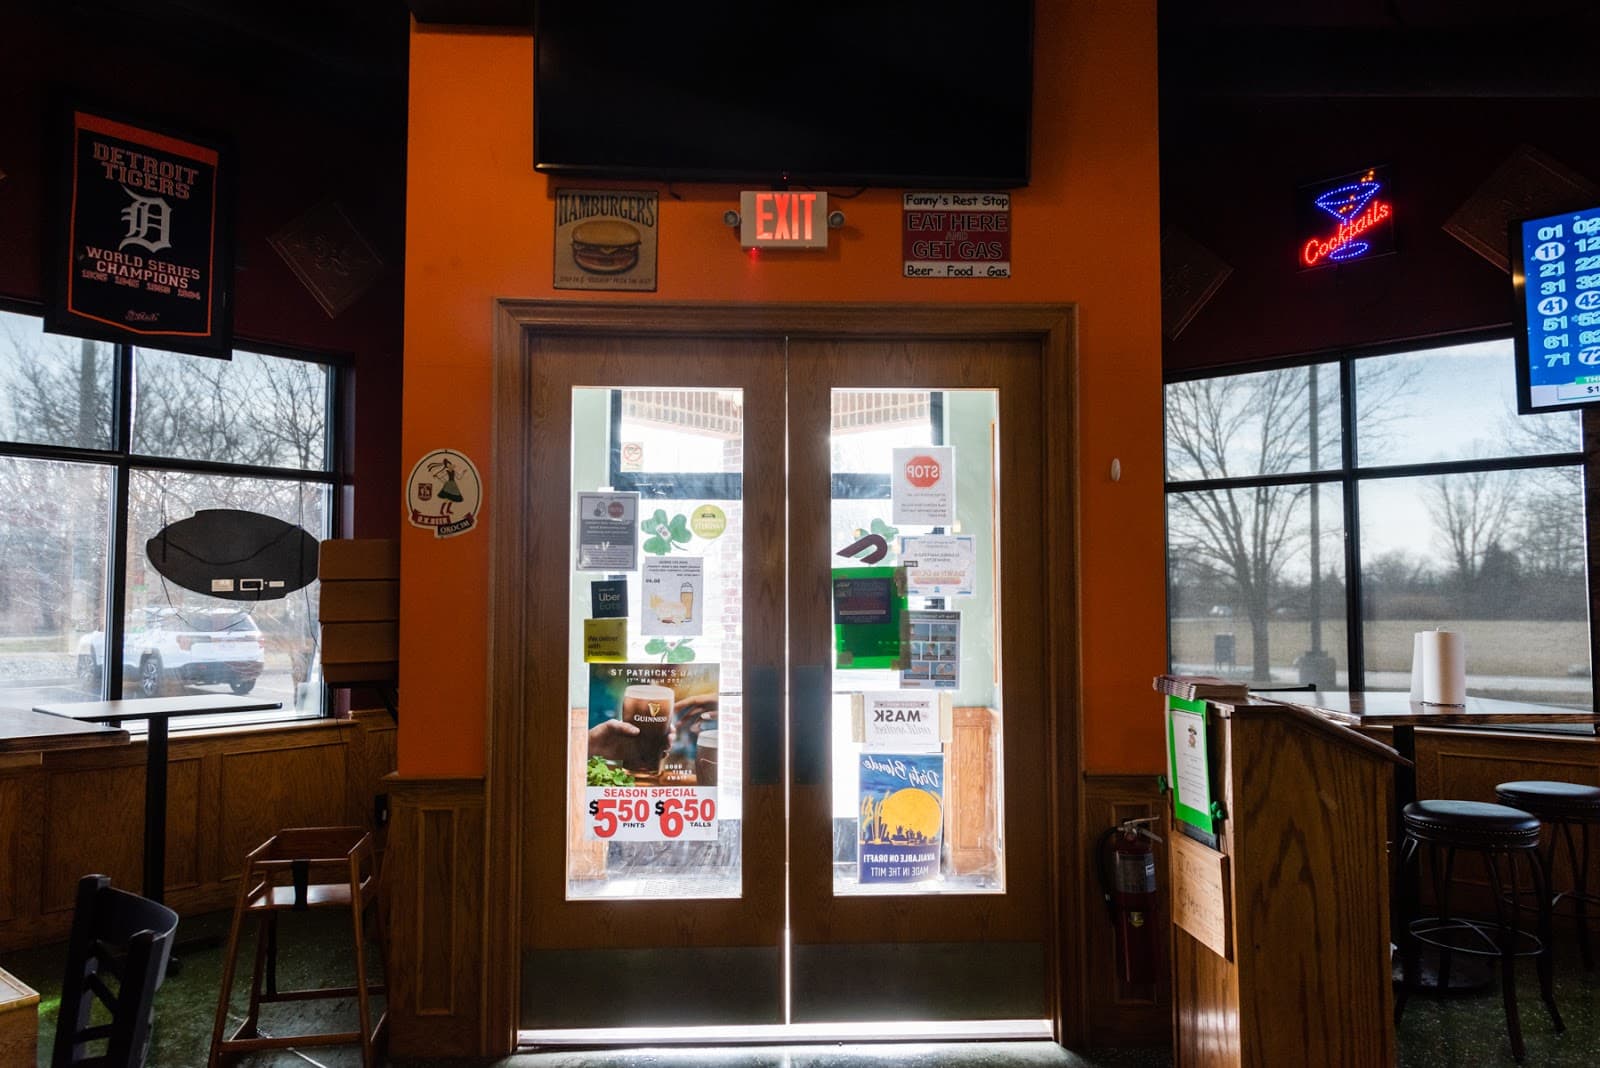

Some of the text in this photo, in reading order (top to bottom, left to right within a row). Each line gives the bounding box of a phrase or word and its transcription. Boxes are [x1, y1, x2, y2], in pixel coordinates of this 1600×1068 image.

[93, 142, 198, 185] DETROIT
[101, 162, 190, 200] TIGERS
[558, 192, 655, 228] HAMBURGERS
[905, 194, 1009, 208] Fanny's Rest Stop
[119, 184, 173, 253] D
[755, 193, 817, 241] EXIT
[908, 213, 1008, 232] EAT HERE
[1304, 201, 1389, 264] Cocktails
[1537, 217, 1600, 241] 01 02
[912, 240, 1003, 260] GET GAS
[1541, 238, 1600, 258] 11 12
[85, 246, 200, 280] WORLD SERIES
[907, 265, 1008, 277] Beer Food Gas
[1539, 256, 1600, 278] 21 22
[96, 260, 189, 289] CHAMPIONS
[1540, 275, 1600, 295] 31 32
[1543, 294, 1600, 313] 41 42
[1543, 312, 1600, 332] 51 52
[1543, 330, 1600, 350] 61 62
[1544, 349, 1600, 368] 71 72
[598, 593, 620, 601] Uber
[626, 669, 676, 677] PATRICK'S
[633, 714, 668, 723] GUINNESS
[604, 788, 697, 798] SEASON SPECIAL
